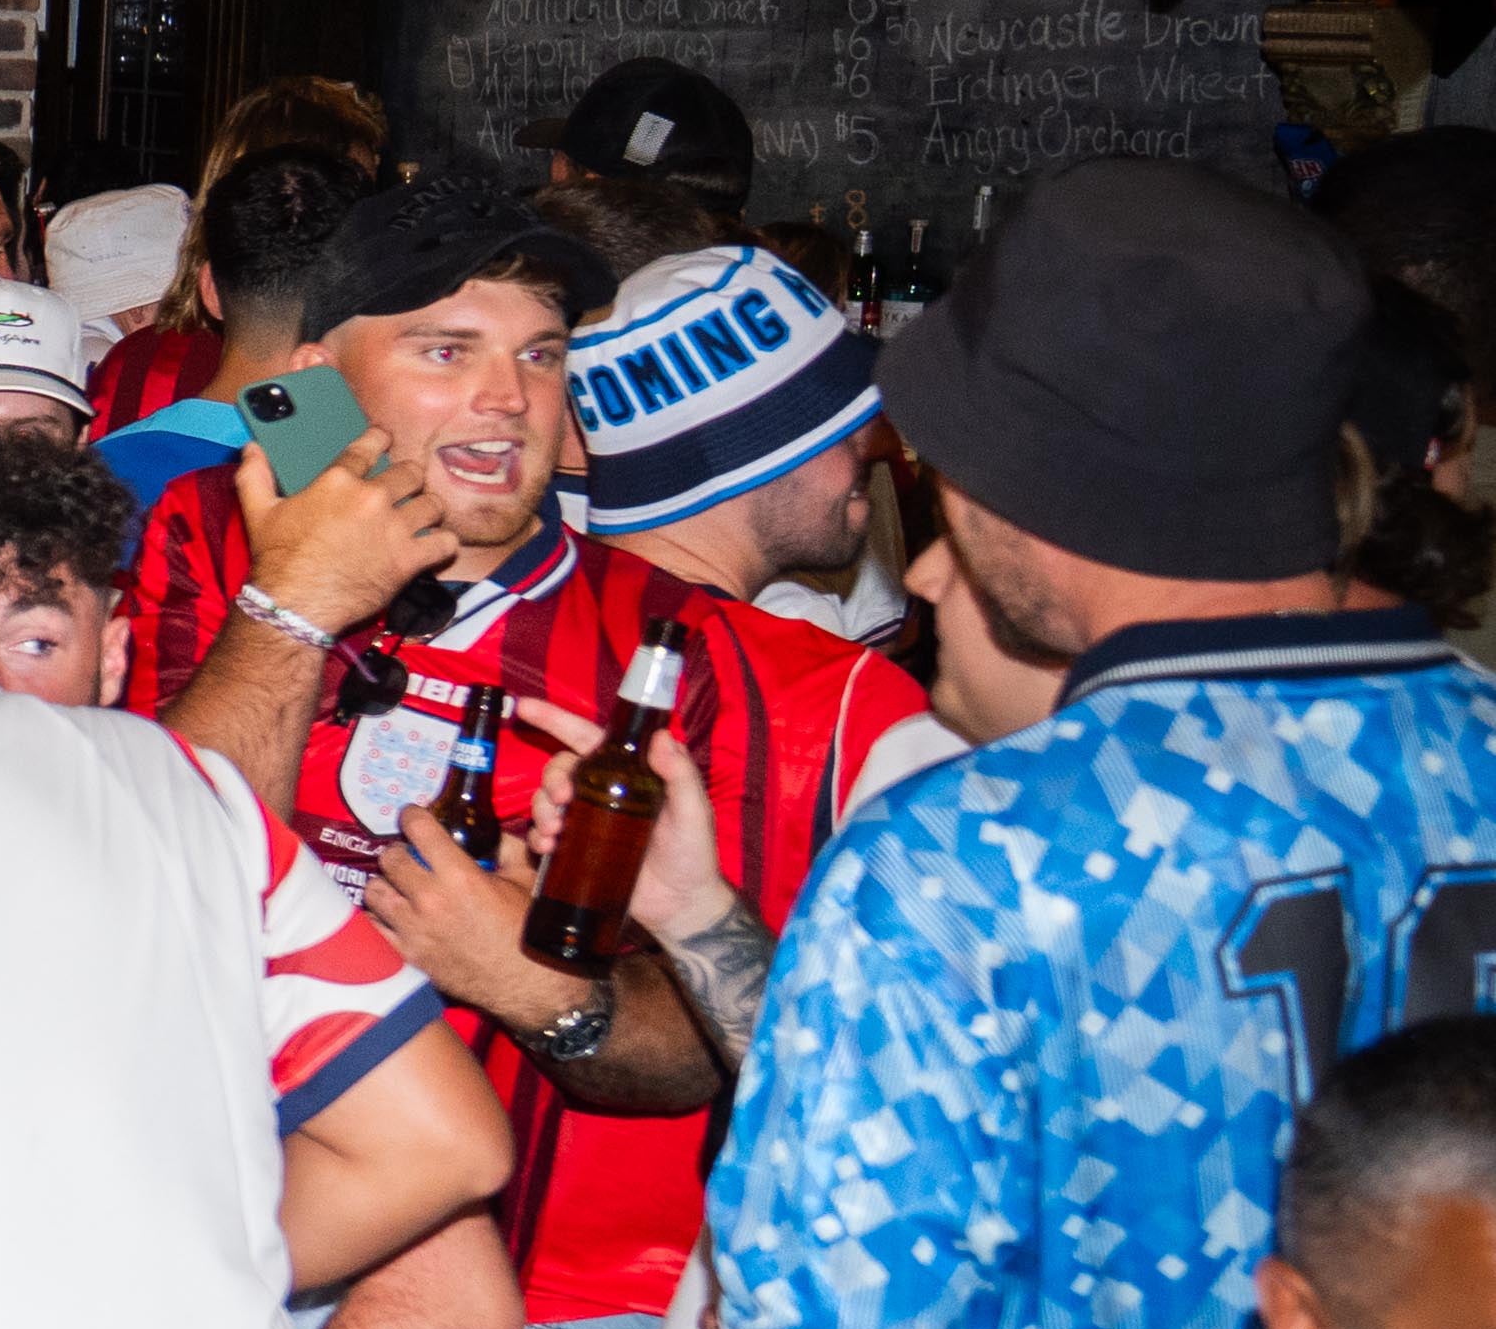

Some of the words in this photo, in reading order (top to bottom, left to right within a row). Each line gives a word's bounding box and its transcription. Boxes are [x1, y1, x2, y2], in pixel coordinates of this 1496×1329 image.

[484, 30, 586, 69] Peroni
[924, 63, 1116, 108] Erdinger
[1138, 54, 1271, 102] Wheat
[835, 111, 880, 166] $5
[922, 109, 1032, 175] Angry
[1037, 105, 1193, 160] Orchard
[568, 287, 792, 433] COMING
[319, 827, 385, 856] ENGLA
